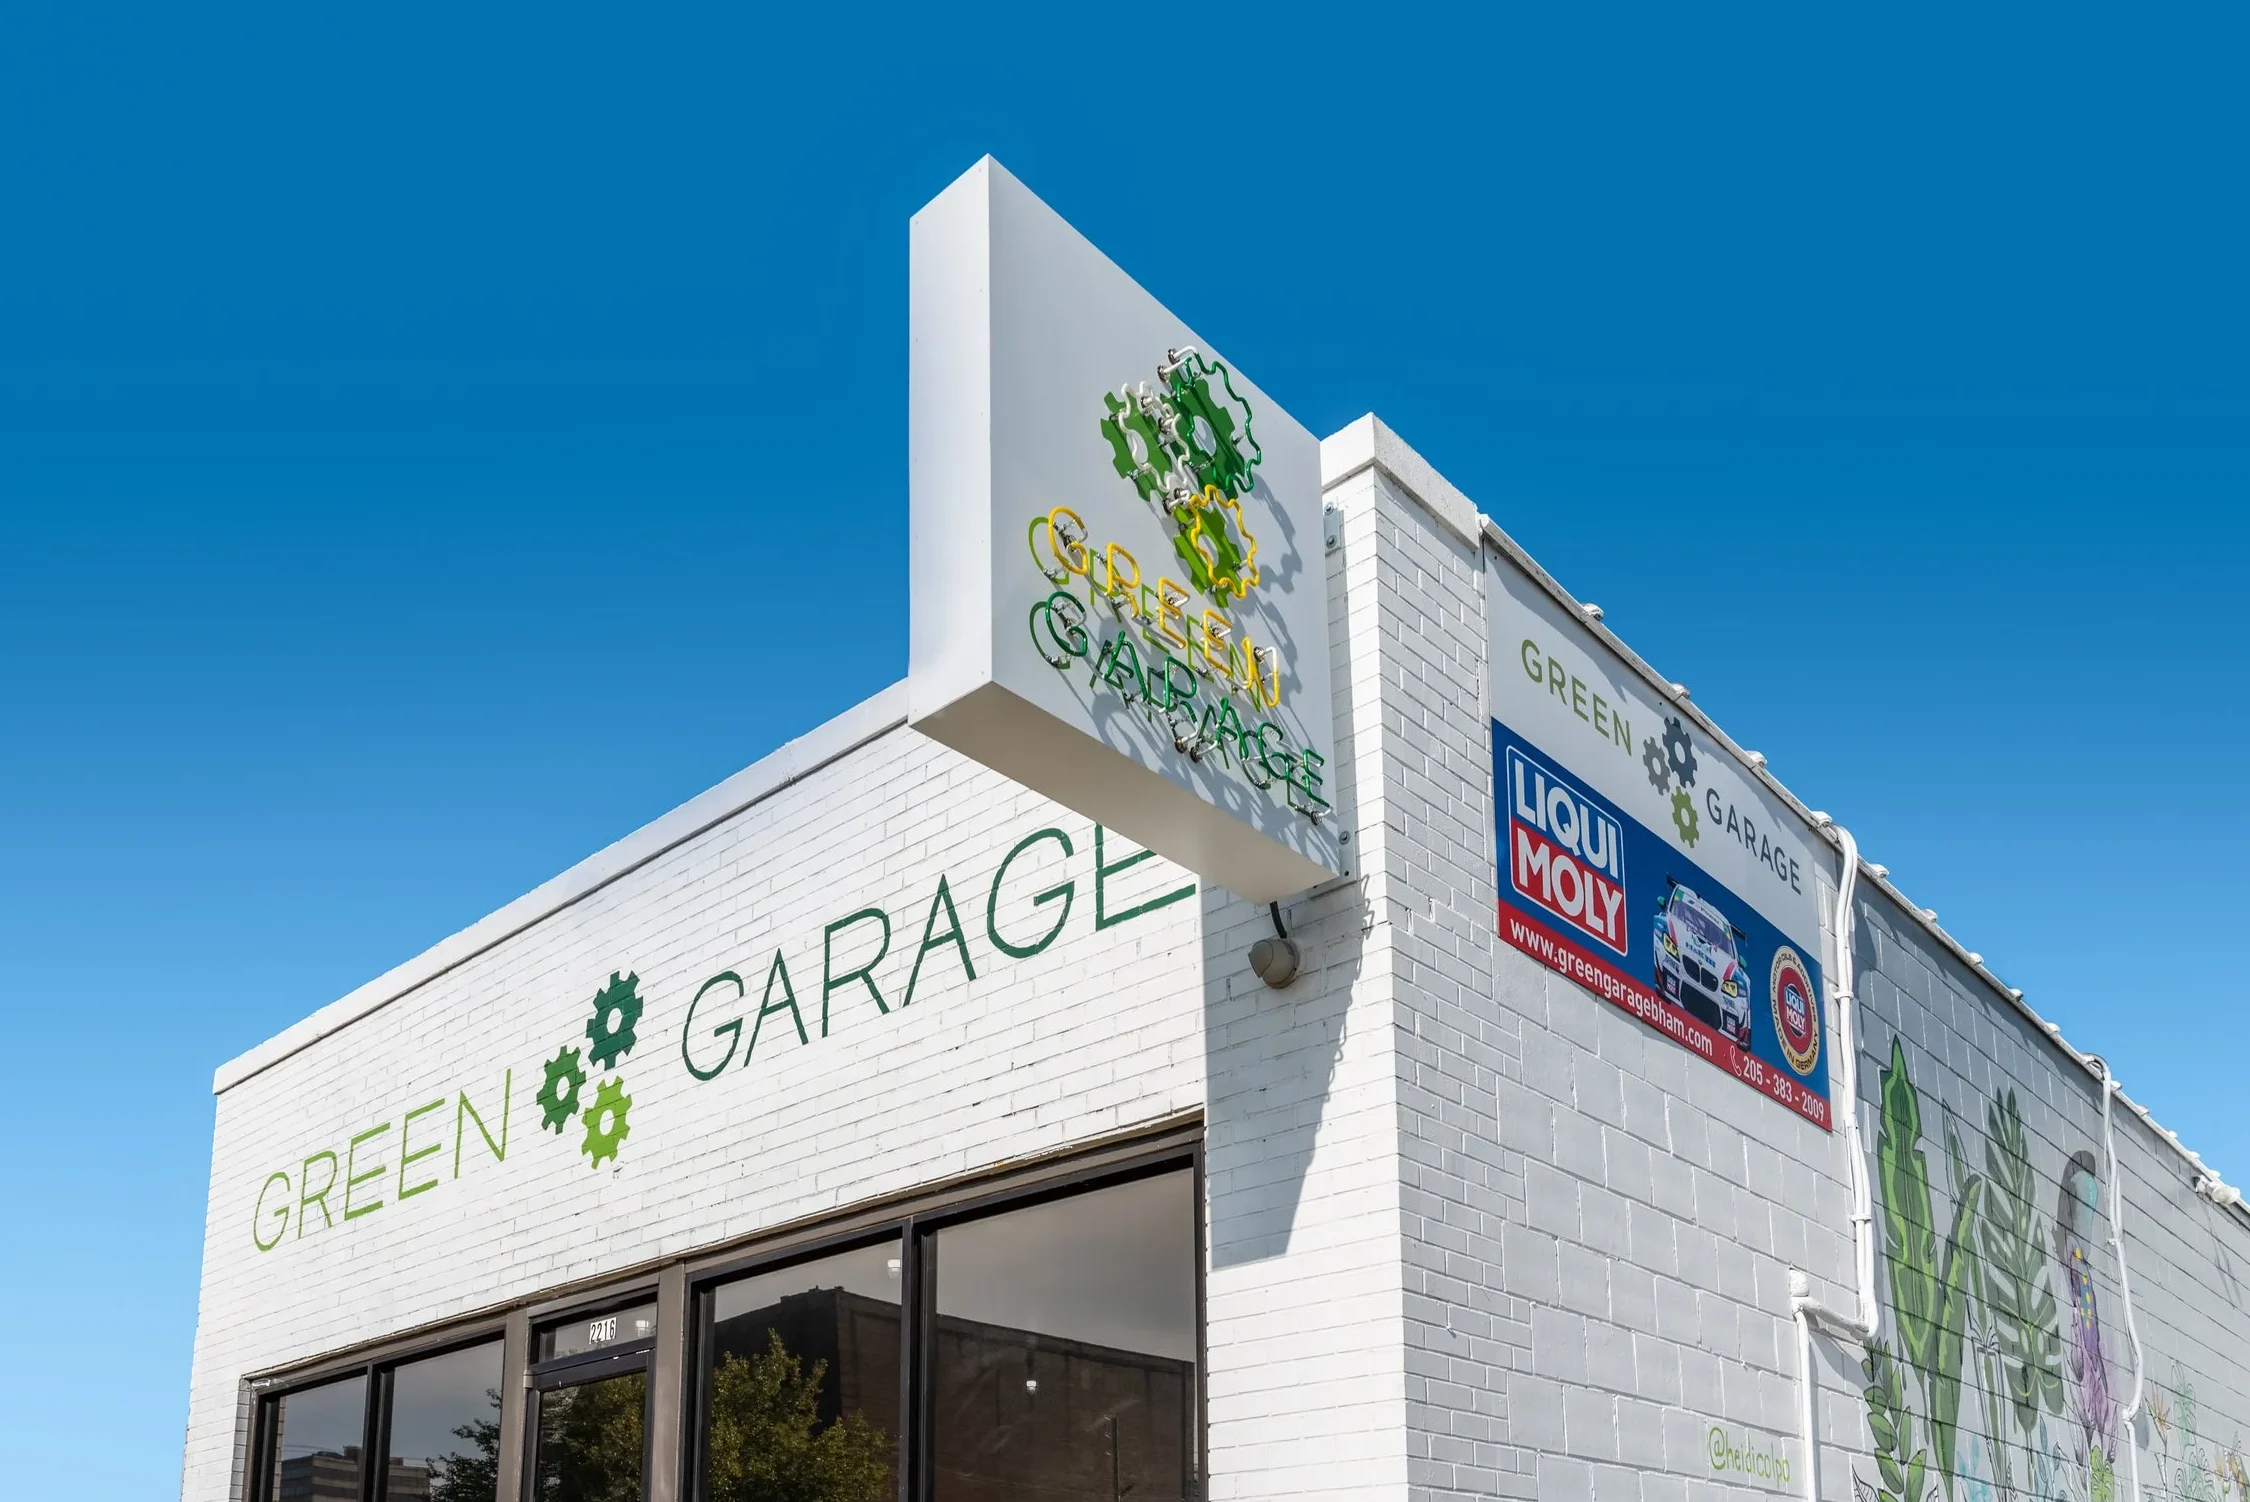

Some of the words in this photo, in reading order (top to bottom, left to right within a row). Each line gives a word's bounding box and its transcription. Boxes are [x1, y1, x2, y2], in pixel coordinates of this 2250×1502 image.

[1029, 506, 1279, 712] GREEN
[1030, 591, 1333, 818] GARAGE
[1521, 639, 1632, 756] GREEN
[1515, 758, 1619, 880] LIQUI
[1706, 788, 1801, 896] GARAGE
[1517, 827, 1623, 941] MOLY
[681, 824, 1196, 1082] GARAGE
[1510, 918, 1713, 1056] www.greengaragebham.com
[1785, 991, 1805, 1015] LIQUI
[1772, 999, 1787, 1049] MADE
[1786, 1049, 1795, 1064] IN
[1795, 1033, 1818, 1070] GERMANY
[1786, 1006, 1805, 1030] MOLY
[1743, 1055, 1763, 1085] 205
[1773, 1073, 1792, 1103] 383
[1801, 1091, 1824, 1122] 2009
[252, 1067, 512, 1253] GREEN
[591, 1319, 615, 1343] 2216
[1709, 1427, 1790, 1490] @heidicolpo
